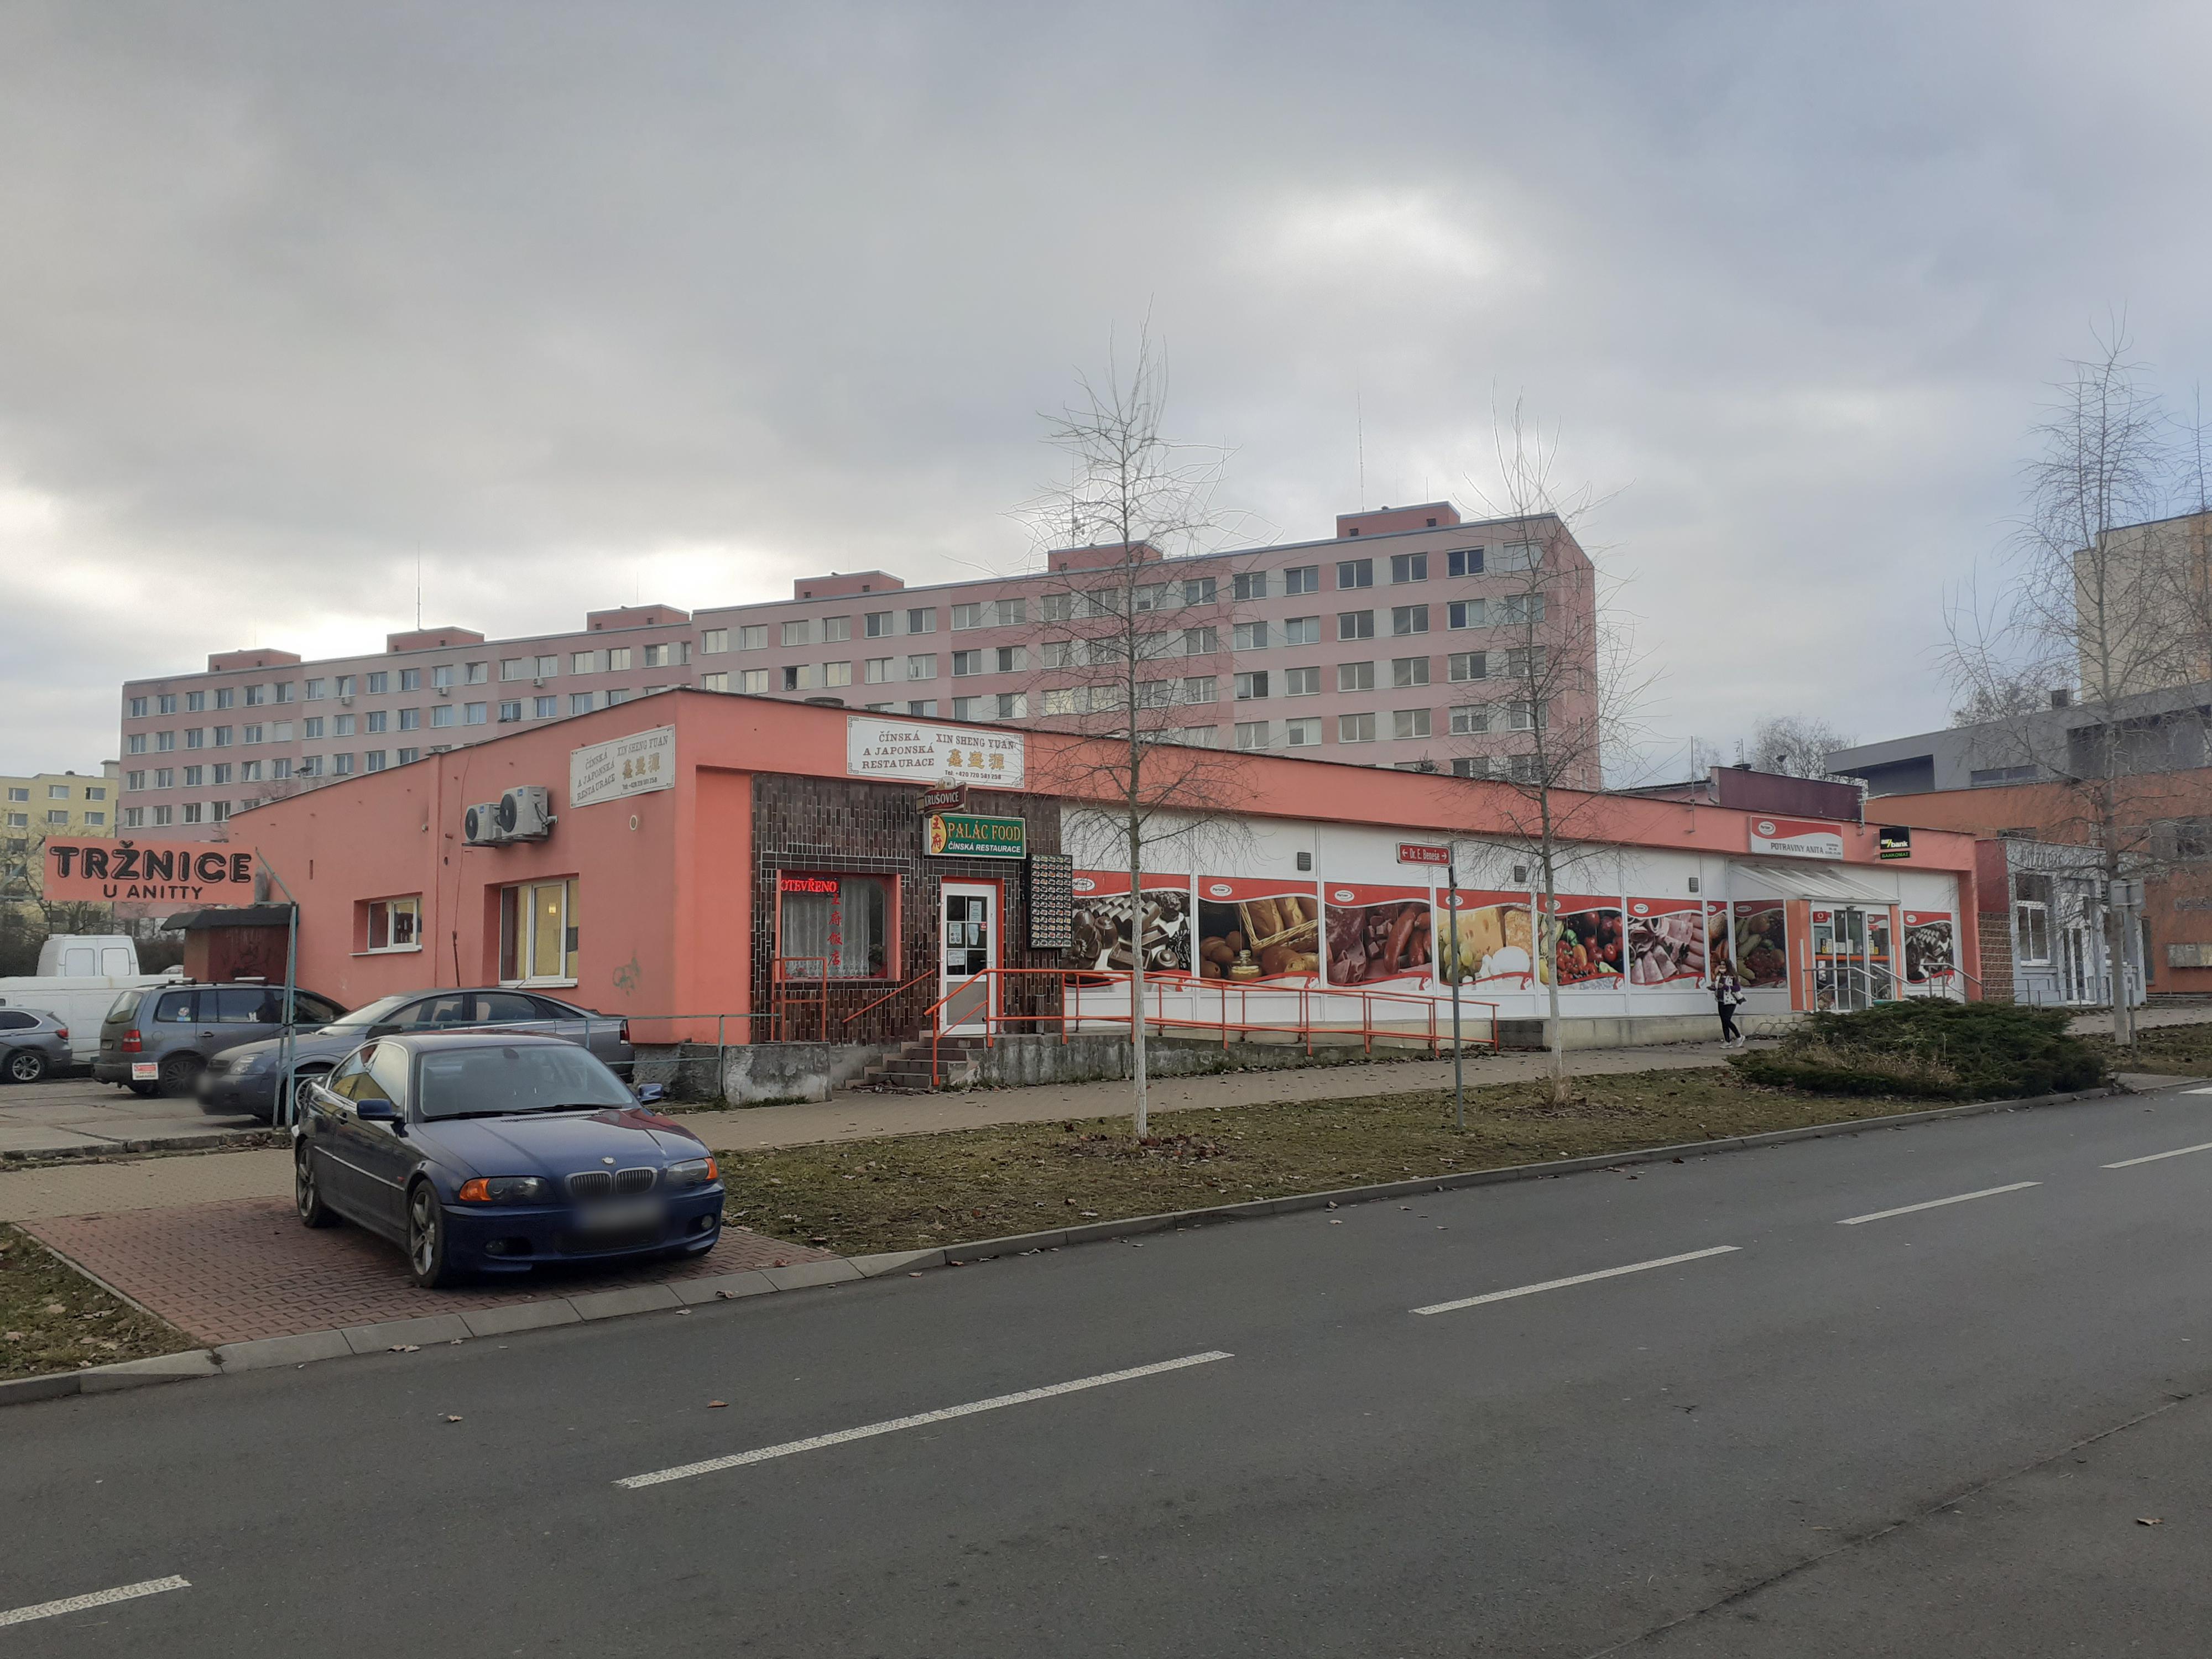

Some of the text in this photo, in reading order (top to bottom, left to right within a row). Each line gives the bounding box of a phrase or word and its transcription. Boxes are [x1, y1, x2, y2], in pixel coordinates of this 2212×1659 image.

[649, 735, 668, 748] YUAN
[879, 730, 920, 742] ČÍNSKÁ
[936, 734, 1014, 749] XIN SHENG YUAN
[875, 742, 935, 755] JAPONSKÁ
[585, 748, 607, 770] ČÍNSKÁ
[862, 758, 935, 769] RESTAURACE
[577, 779, 582, 787] A
[577, 773, 615, 801] RESTAURACE
[925, 791, 959, 807] KRUŠOVICE
[948, 821, 1021, 841] PALÁC FOOD
[948, 841, 1021, 853] ČÍNSKÁ RESTAURACE
[1771, 842, 1804, 852] POTRAVINY
[1806, 846, 1824, 854] ANITA
[50, 840, 252, 883] TRŽNICE
[1417, 848, 1422, 859] E.
[1423, 849, 1440, 861] Beneše
[103, 884, 203, 900] U ANITTY
[781, 877, 838, 893] OTEVŘENO
